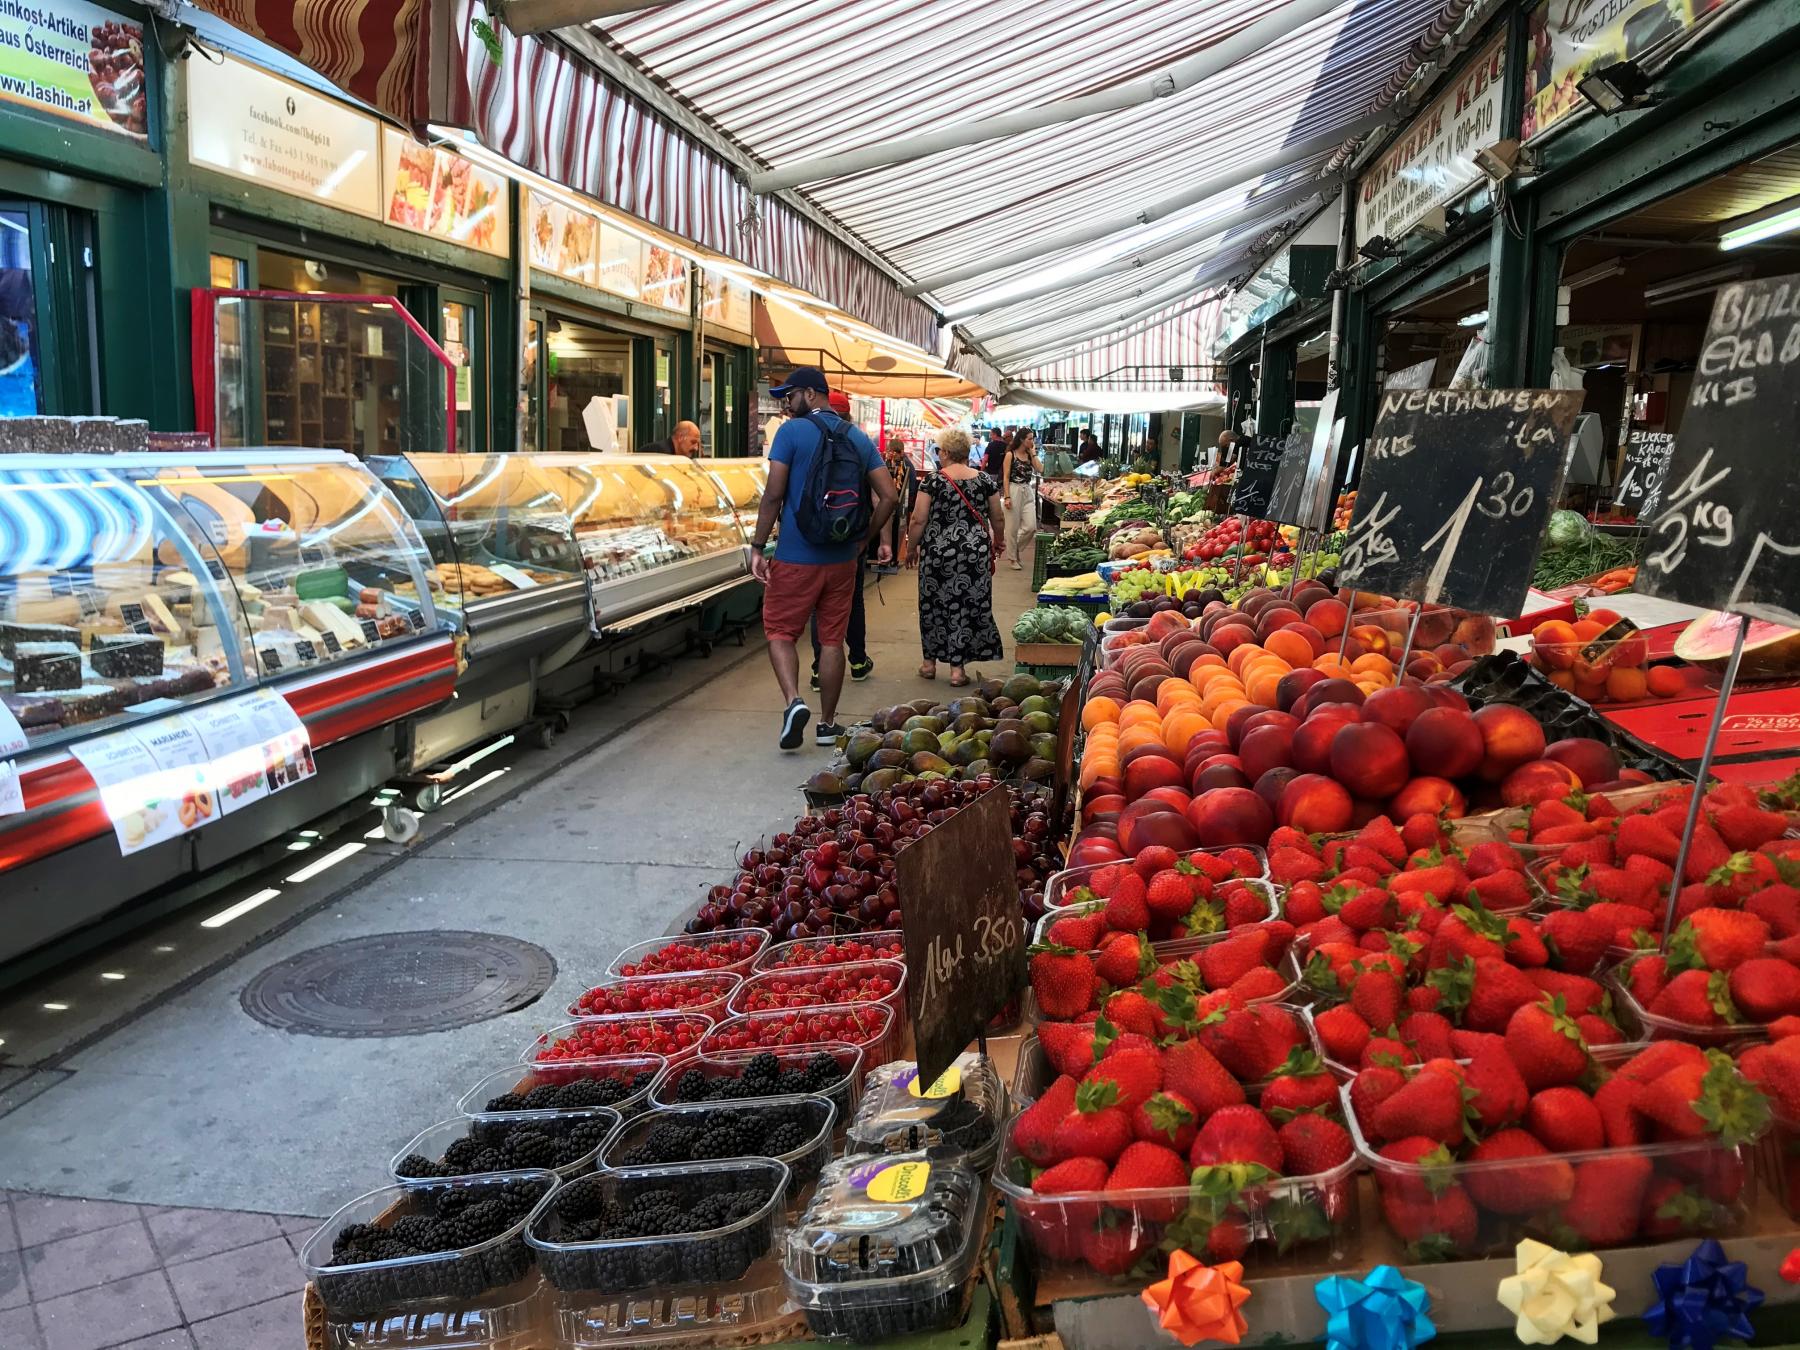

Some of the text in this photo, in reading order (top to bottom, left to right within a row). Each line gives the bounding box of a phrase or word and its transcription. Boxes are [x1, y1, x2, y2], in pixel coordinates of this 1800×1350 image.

[25, 25, 90, 72] Österreich
[1455, 98, 1494, 156] 609-610
[1630, 431, 1674, 444] ZUCKER
